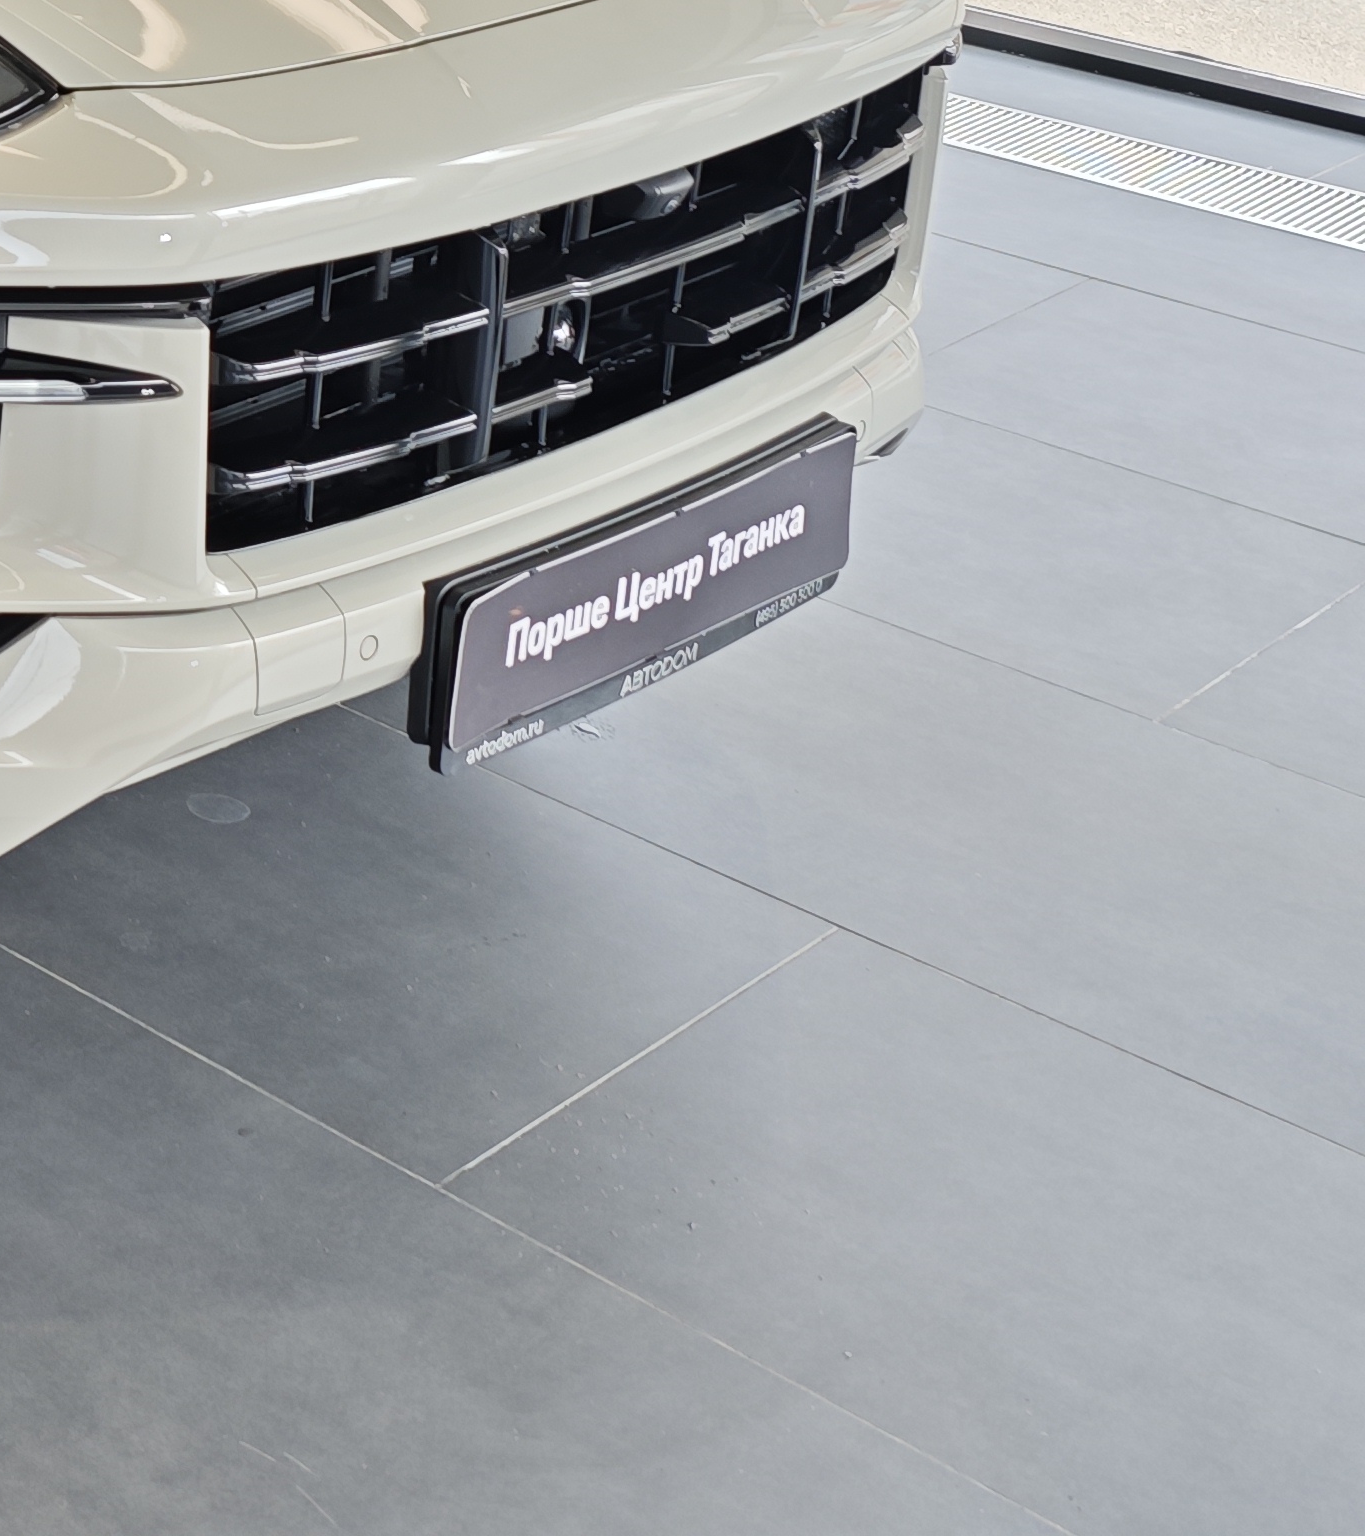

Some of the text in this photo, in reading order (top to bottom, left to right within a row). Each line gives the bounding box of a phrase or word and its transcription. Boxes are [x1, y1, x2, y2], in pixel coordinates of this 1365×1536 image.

[505, 504, 806, 668] Порше Центр Таганка
[465, 718, 545, 766] avtodom.ru
